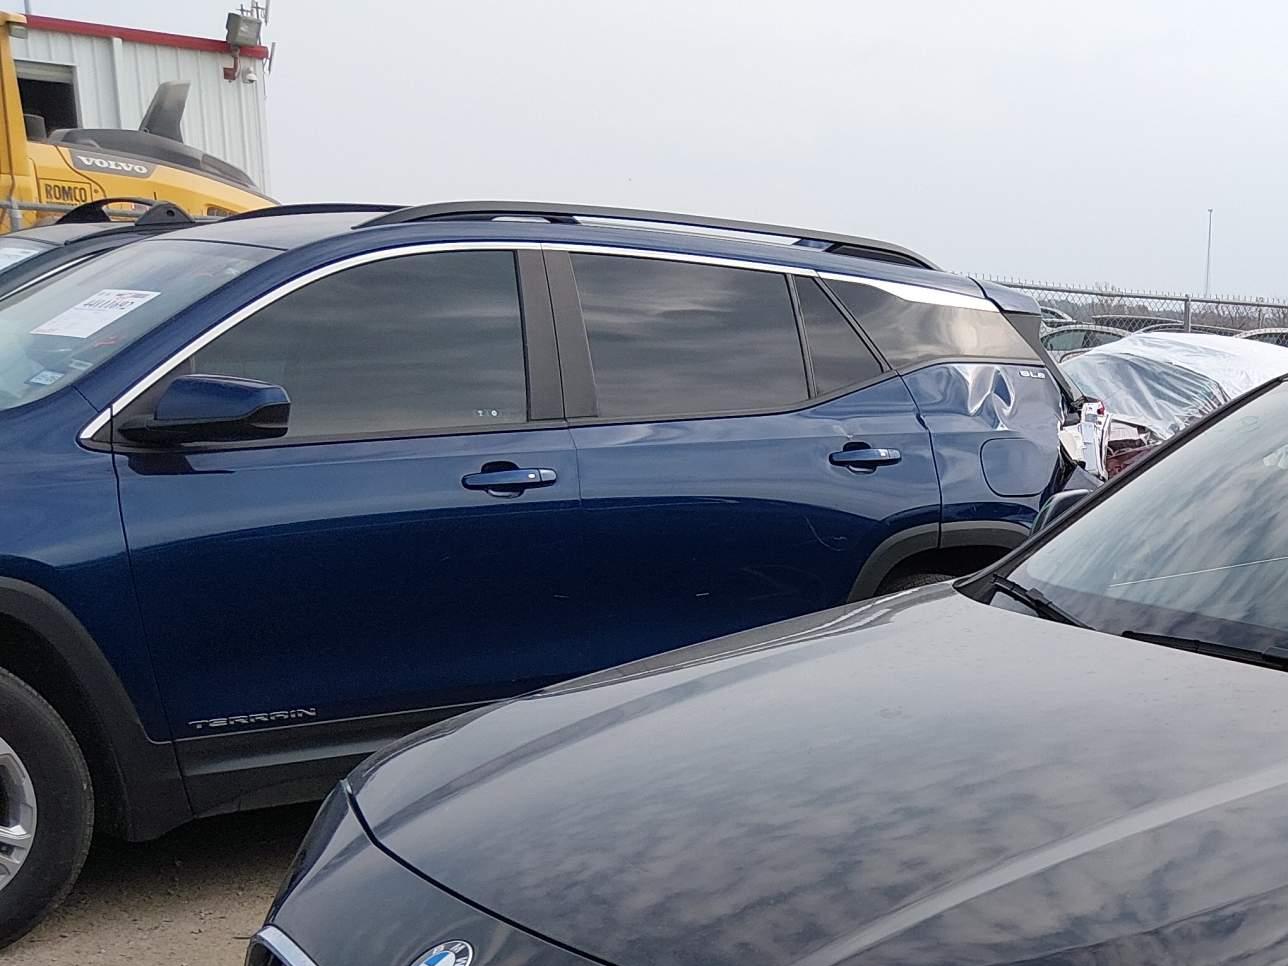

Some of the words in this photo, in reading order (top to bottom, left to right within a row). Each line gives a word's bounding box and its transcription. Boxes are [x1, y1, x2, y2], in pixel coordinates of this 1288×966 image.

[77, 155, 148, 174] VOLVO
[45, 183, 88, 203] ROMCO
[188, 707, 316, 729] TERRAIN
